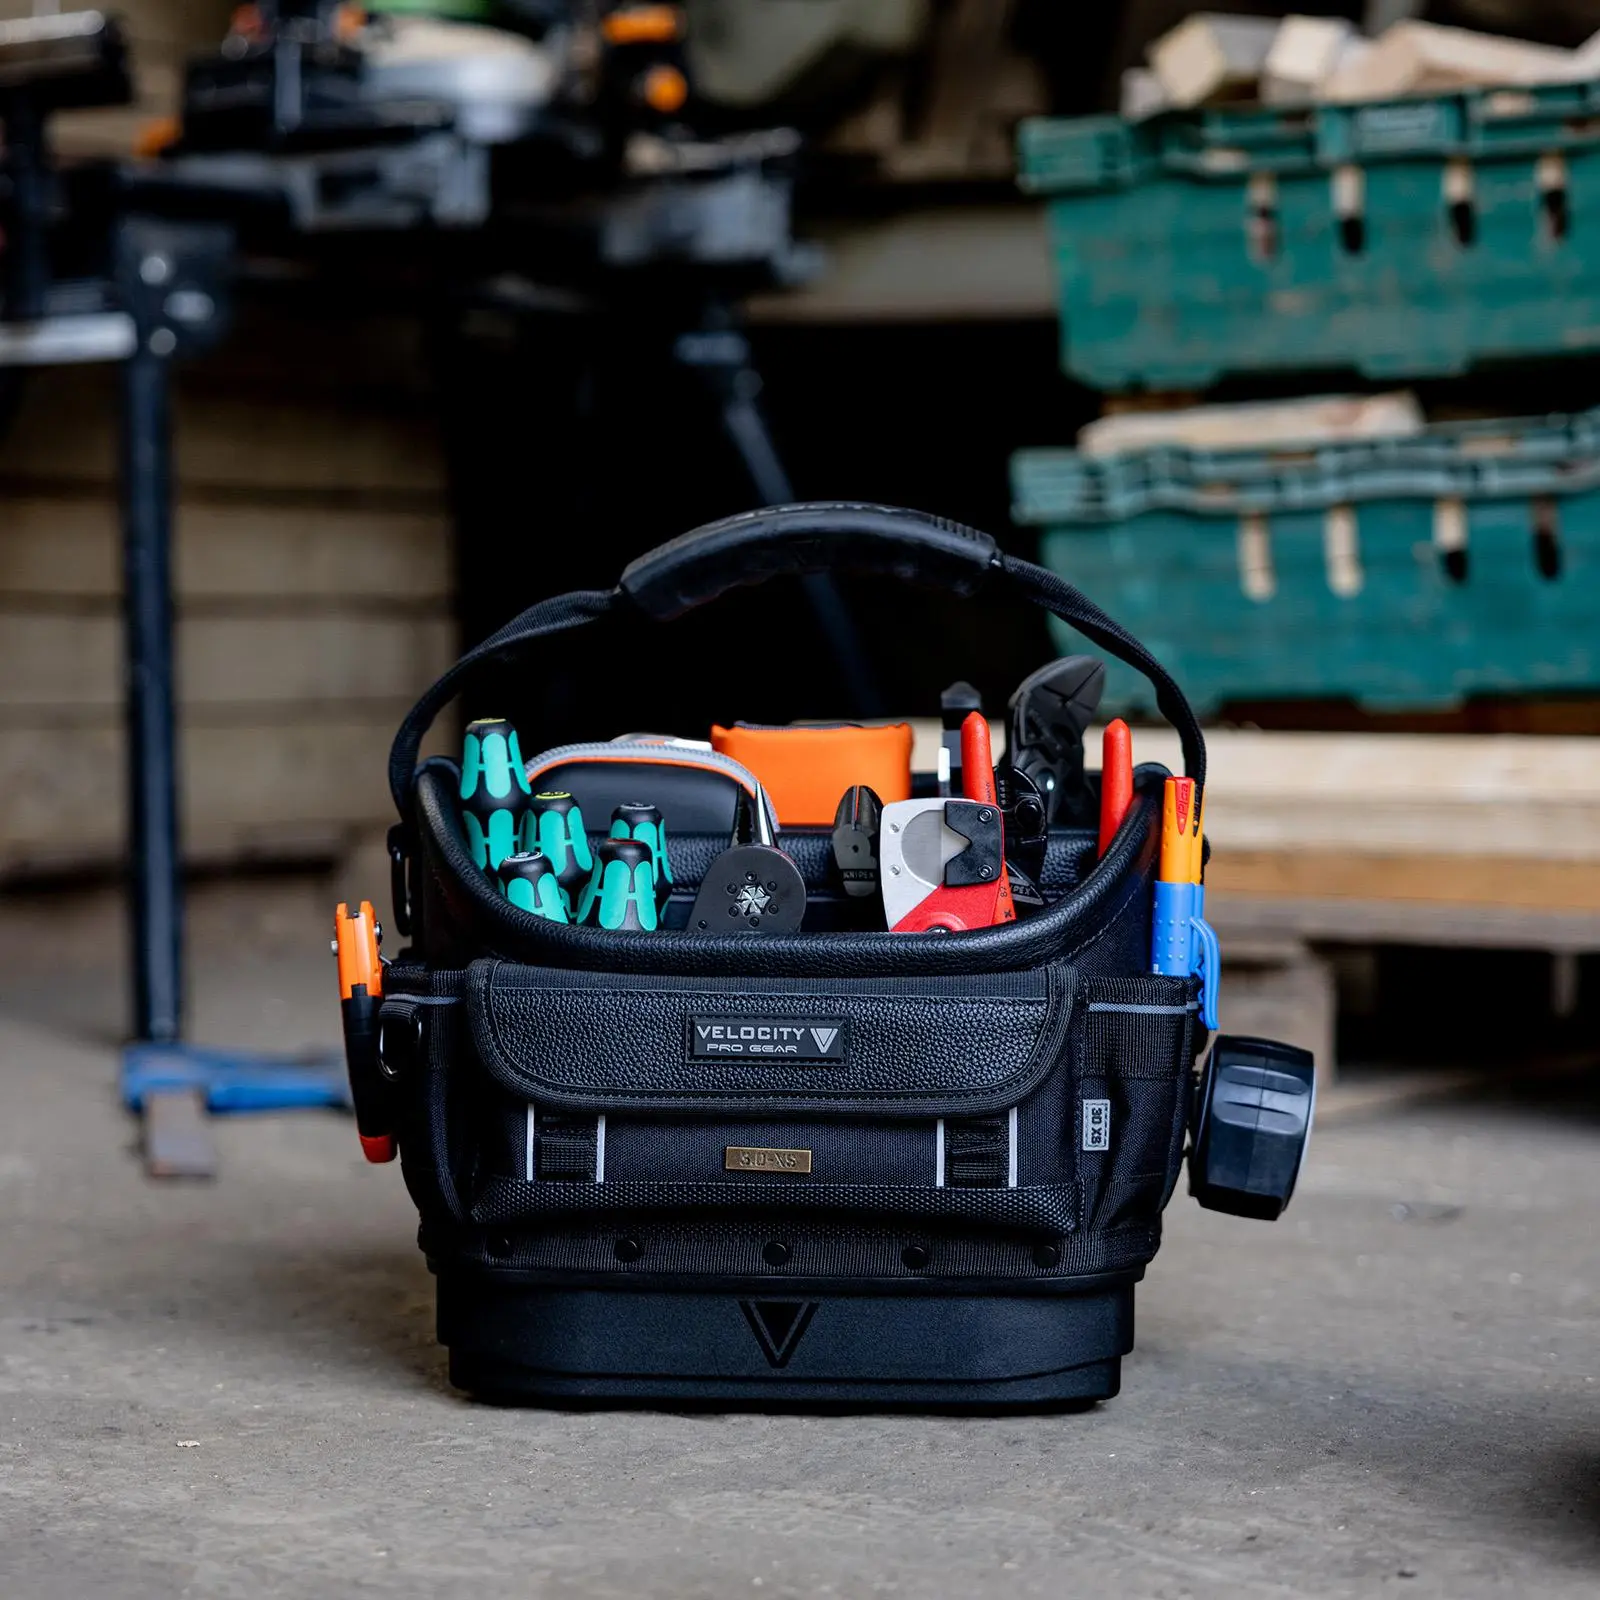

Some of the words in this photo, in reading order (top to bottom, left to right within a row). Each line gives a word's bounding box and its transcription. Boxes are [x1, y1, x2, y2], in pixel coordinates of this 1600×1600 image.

[697, 1025, 805, 1040] VELOCITY
[706, 1043, 743, 1052] PRO
[749, 1044, 798, 1053] GEAR
